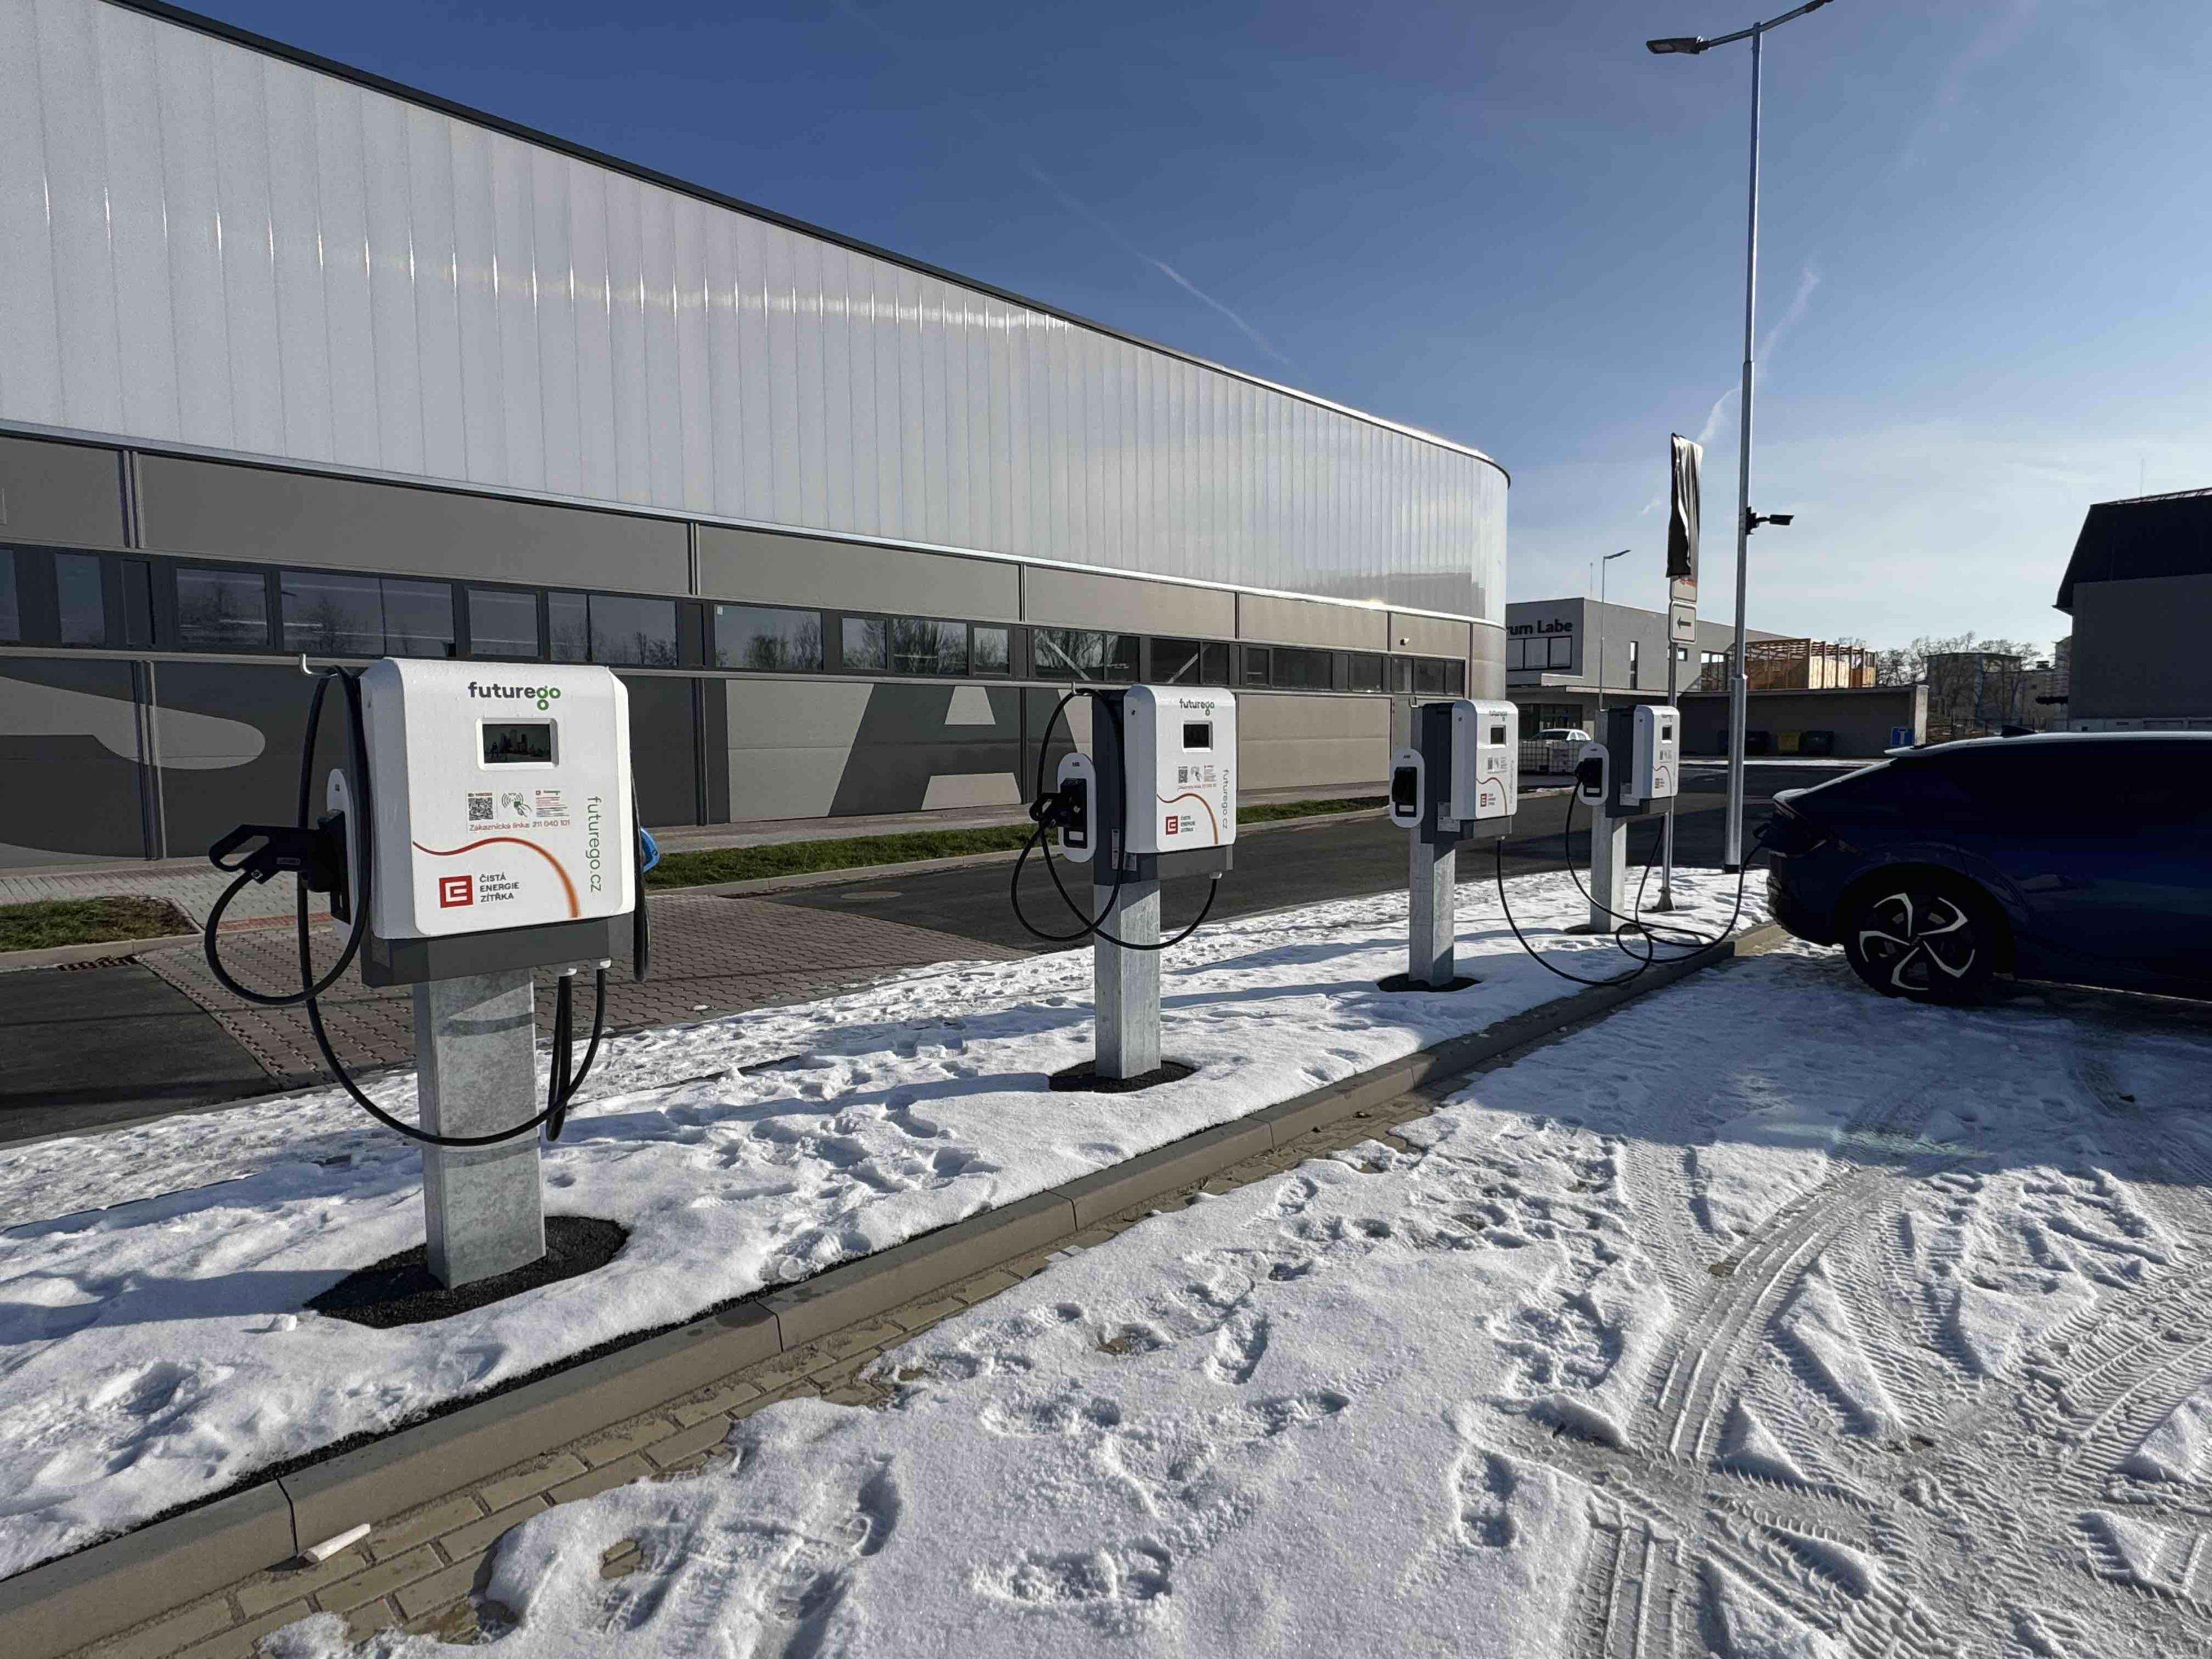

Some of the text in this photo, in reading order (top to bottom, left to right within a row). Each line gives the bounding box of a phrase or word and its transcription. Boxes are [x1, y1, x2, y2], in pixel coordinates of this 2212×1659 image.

[1537, 619, 1573, 633] Labe
[468, 681, 561, 711] futurego
[1179, 697, 1215, 716] futurego
[585, 795, 602, 893] futurego.cz
[479, 872, 507, 883] ČISTÁ
[479, 881, 520, 893] ENERGIE
[480, 891, 514, 903] ZÍTŘKA
